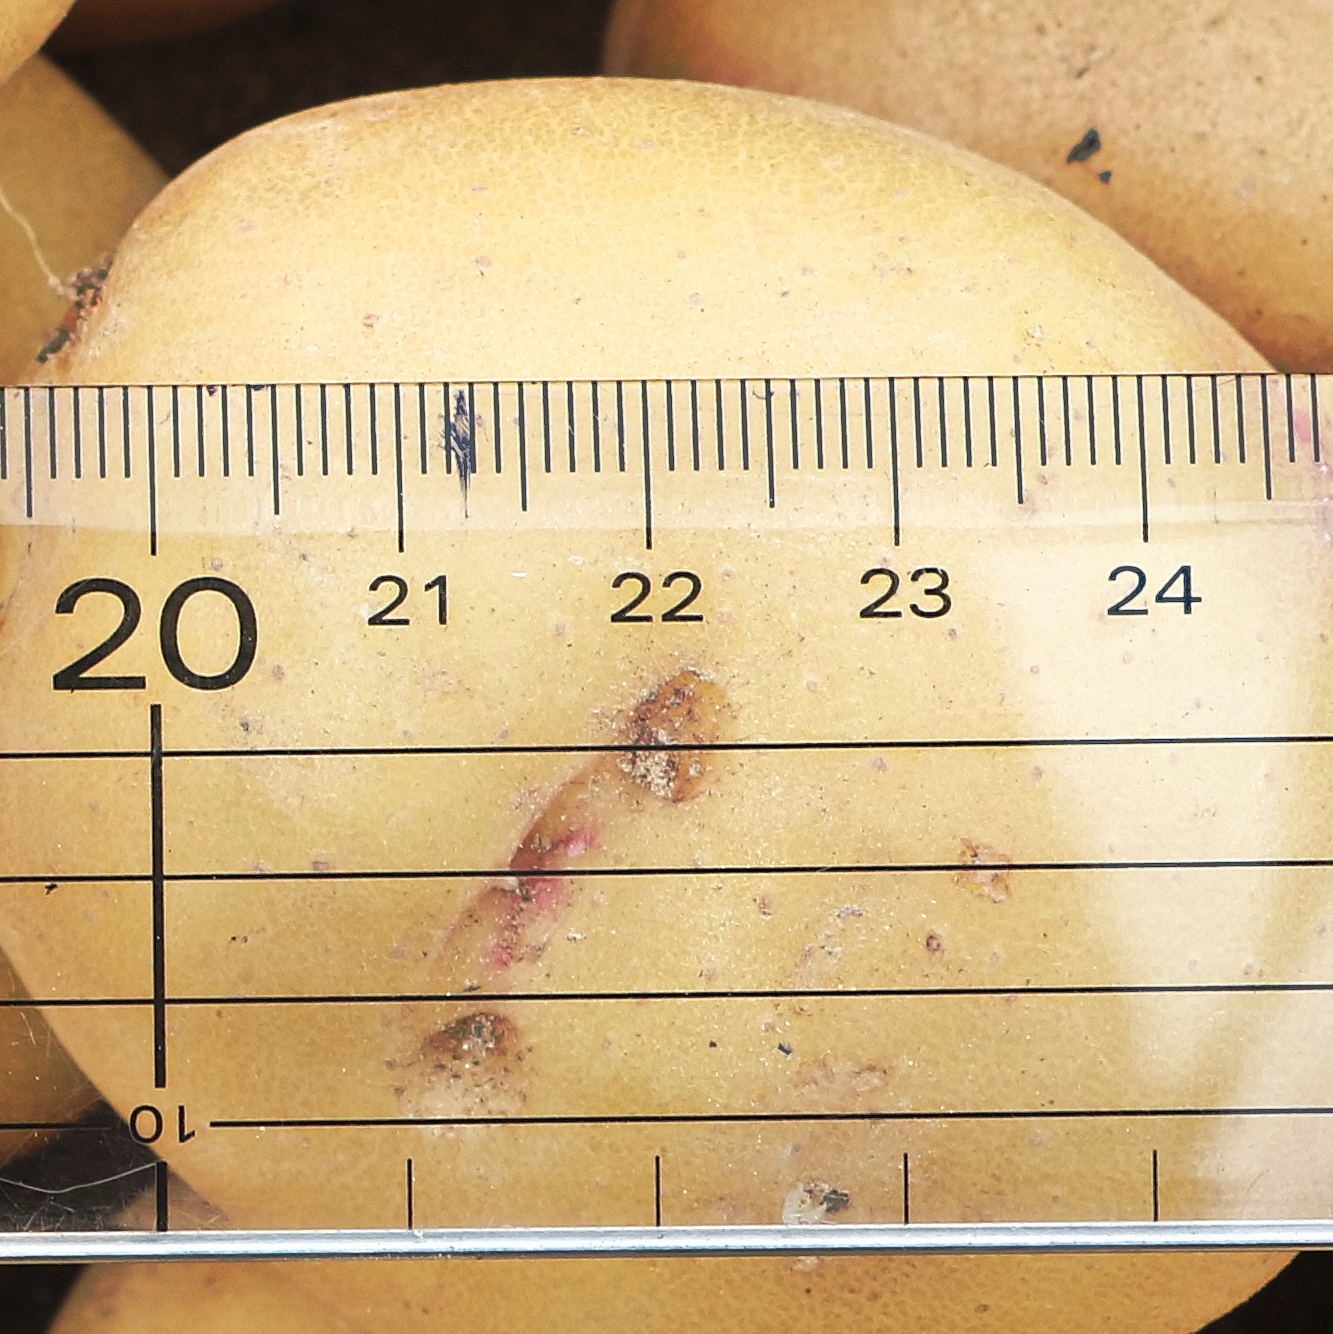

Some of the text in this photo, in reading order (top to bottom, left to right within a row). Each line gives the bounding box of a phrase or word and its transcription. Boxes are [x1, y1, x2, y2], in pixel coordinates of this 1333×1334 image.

[53, 577, 257, 693] 20
[368, 575, 447, 625] 21
[611, 572, 703, 622] 22
[860, 568, 951, 618] 23
[1108, 566, 1202, 615] 24
[130, 1105, 195, 1143] 10
